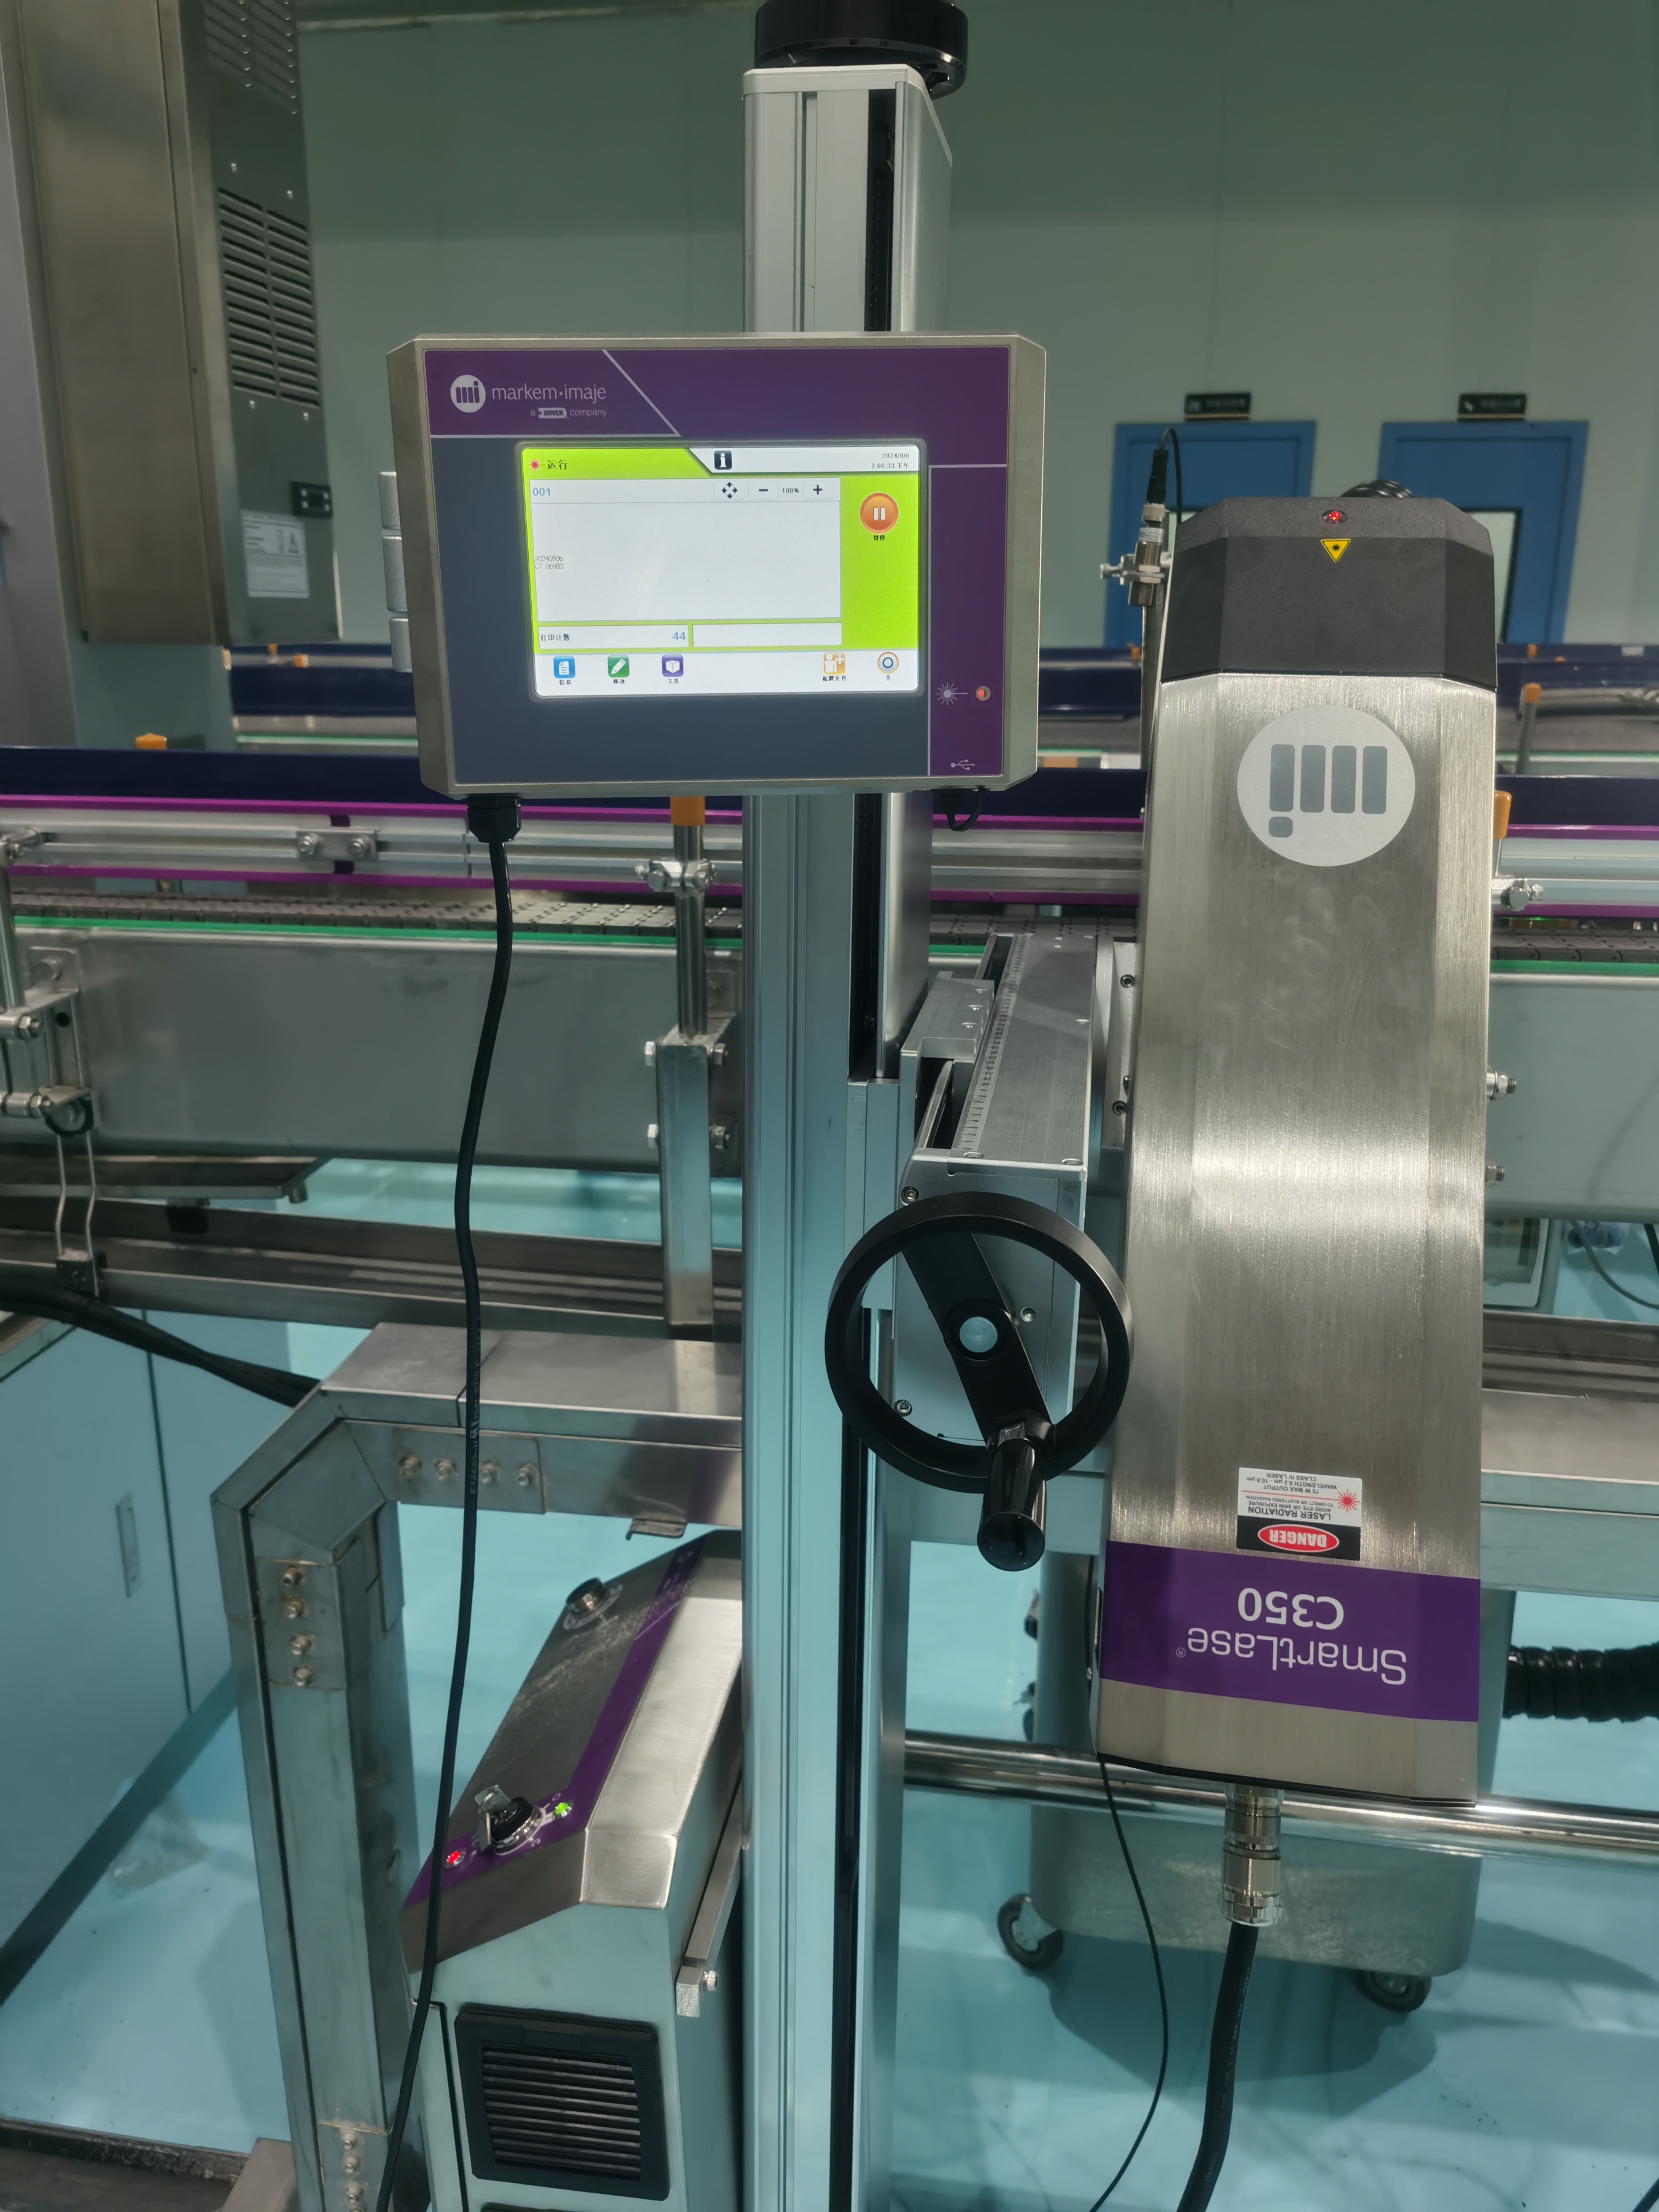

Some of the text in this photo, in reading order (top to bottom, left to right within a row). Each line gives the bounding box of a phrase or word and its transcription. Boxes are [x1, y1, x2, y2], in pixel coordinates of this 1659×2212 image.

[547, 459, 568, 470] 运行
[532, 488, 551, 496] 001
[672, 631, 686, 641] 44
[1294, 1481, 1337, 1490] WAVELENGTH
[1248, 1506, 1331, 1521] LASER RADIATION
[1269, 1529, 1327, 1548] DANGER
[1238, 1587, 1344, 1630] C350
